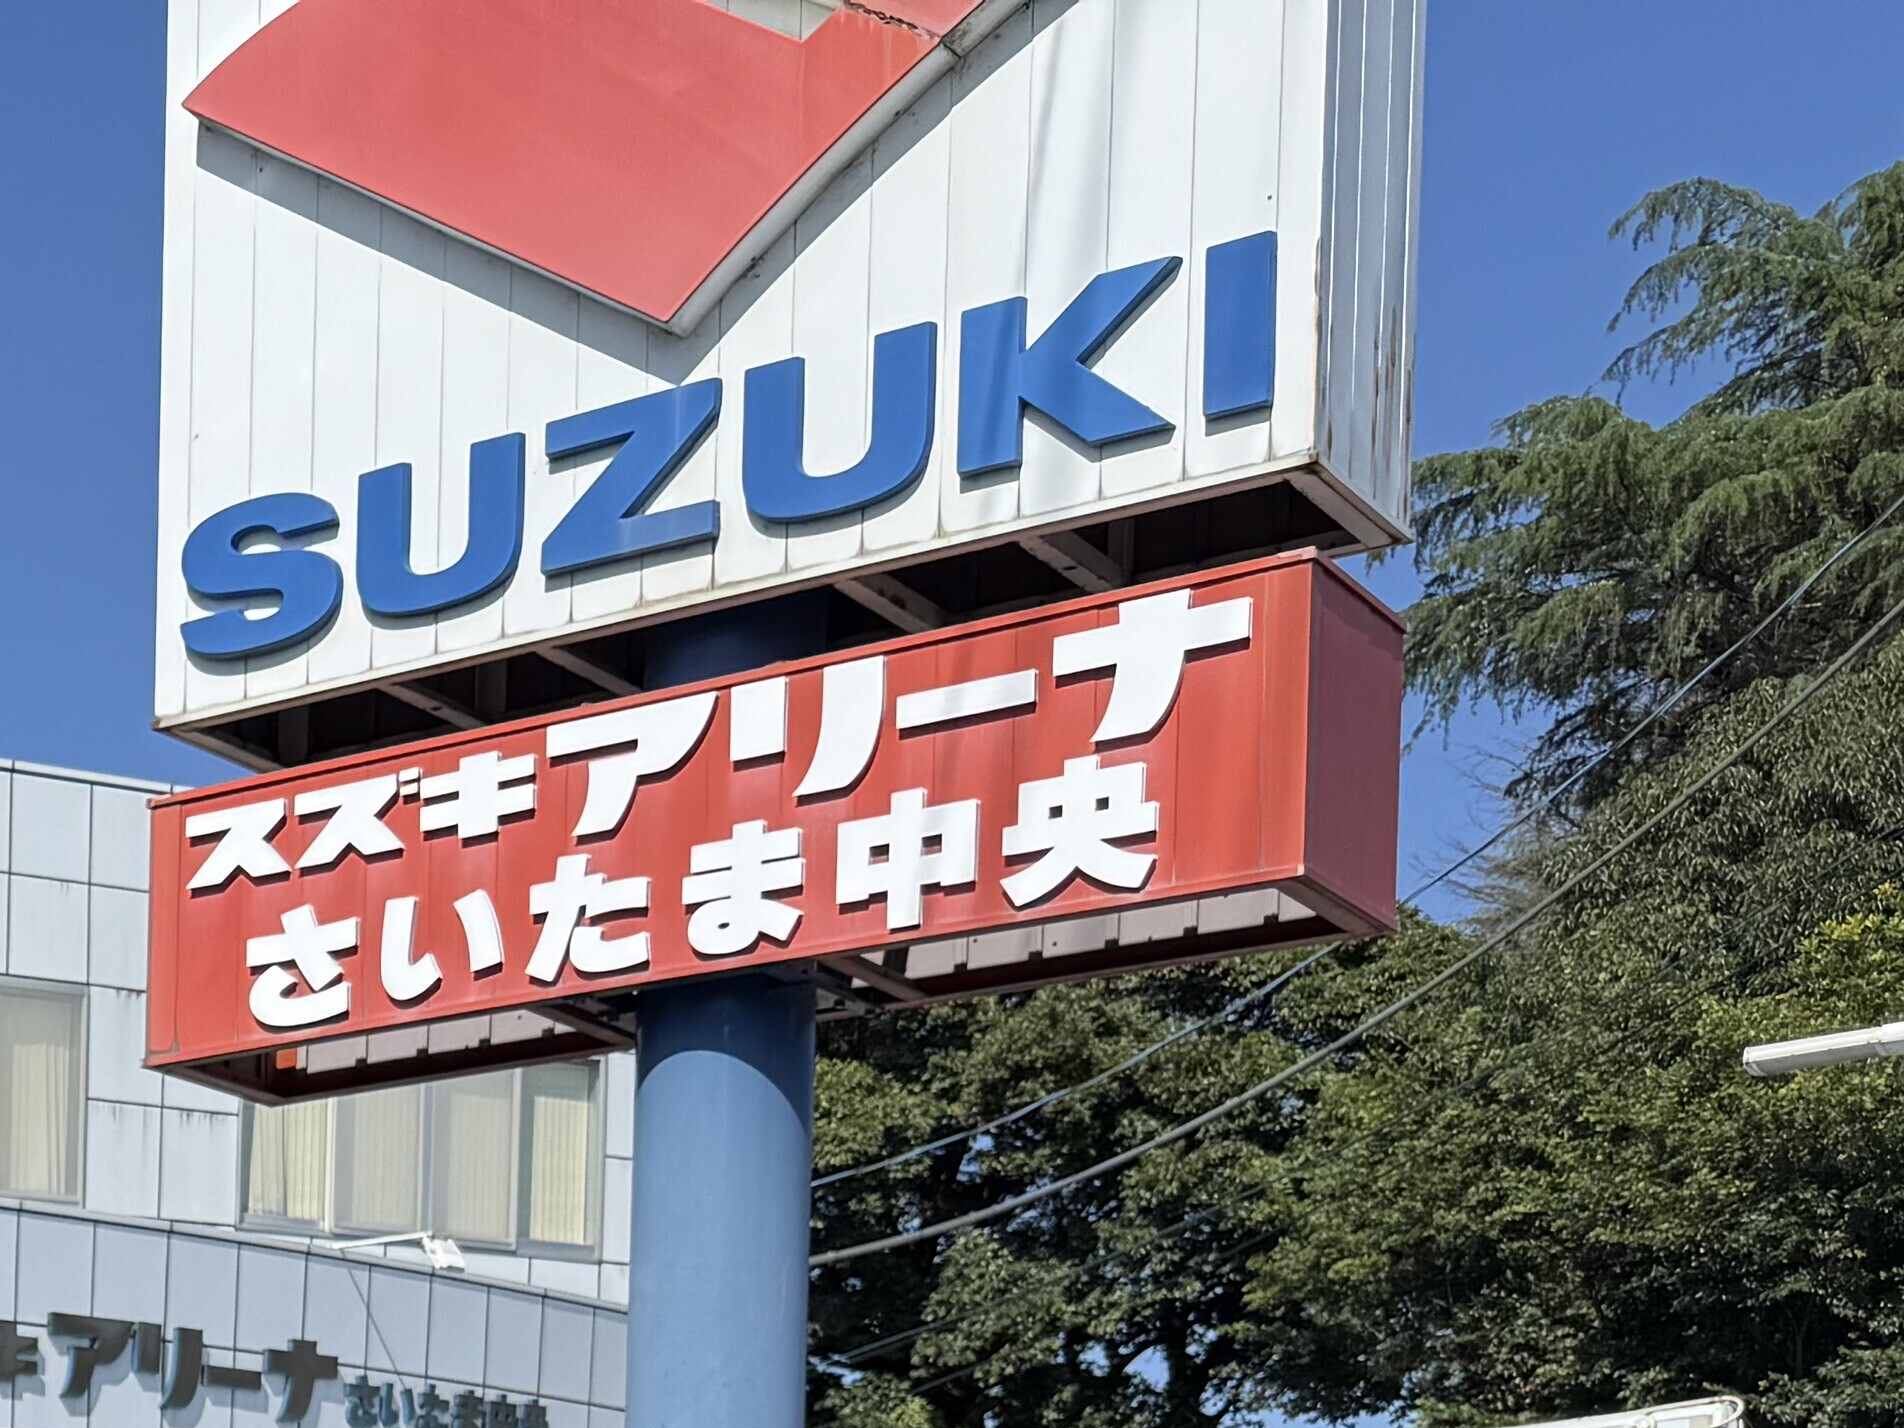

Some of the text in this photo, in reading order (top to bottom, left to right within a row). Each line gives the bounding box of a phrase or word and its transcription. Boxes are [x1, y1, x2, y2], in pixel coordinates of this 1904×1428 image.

[179, 229, 1278, 662] SUZUKI
[185, 590, 1253, 892] スズキアリーナ
[245, 754, 1159, 1031] さいたま中央
